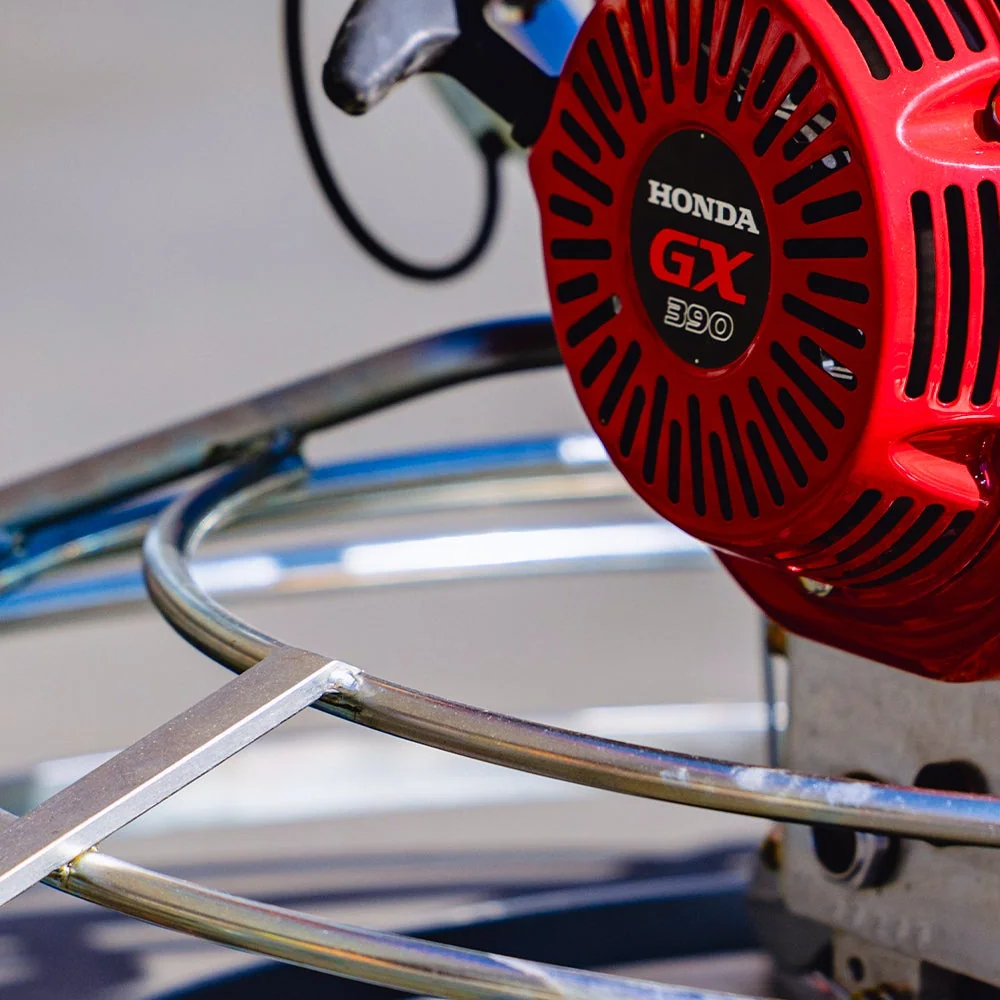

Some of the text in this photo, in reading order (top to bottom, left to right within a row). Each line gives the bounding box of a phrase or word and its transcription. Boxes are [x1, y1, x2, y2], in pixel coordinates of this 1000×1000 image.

[647, 179, 760, 235] HONDA
[649, 227, 755, 306] GX
[663, 296, 734, 342] 390
